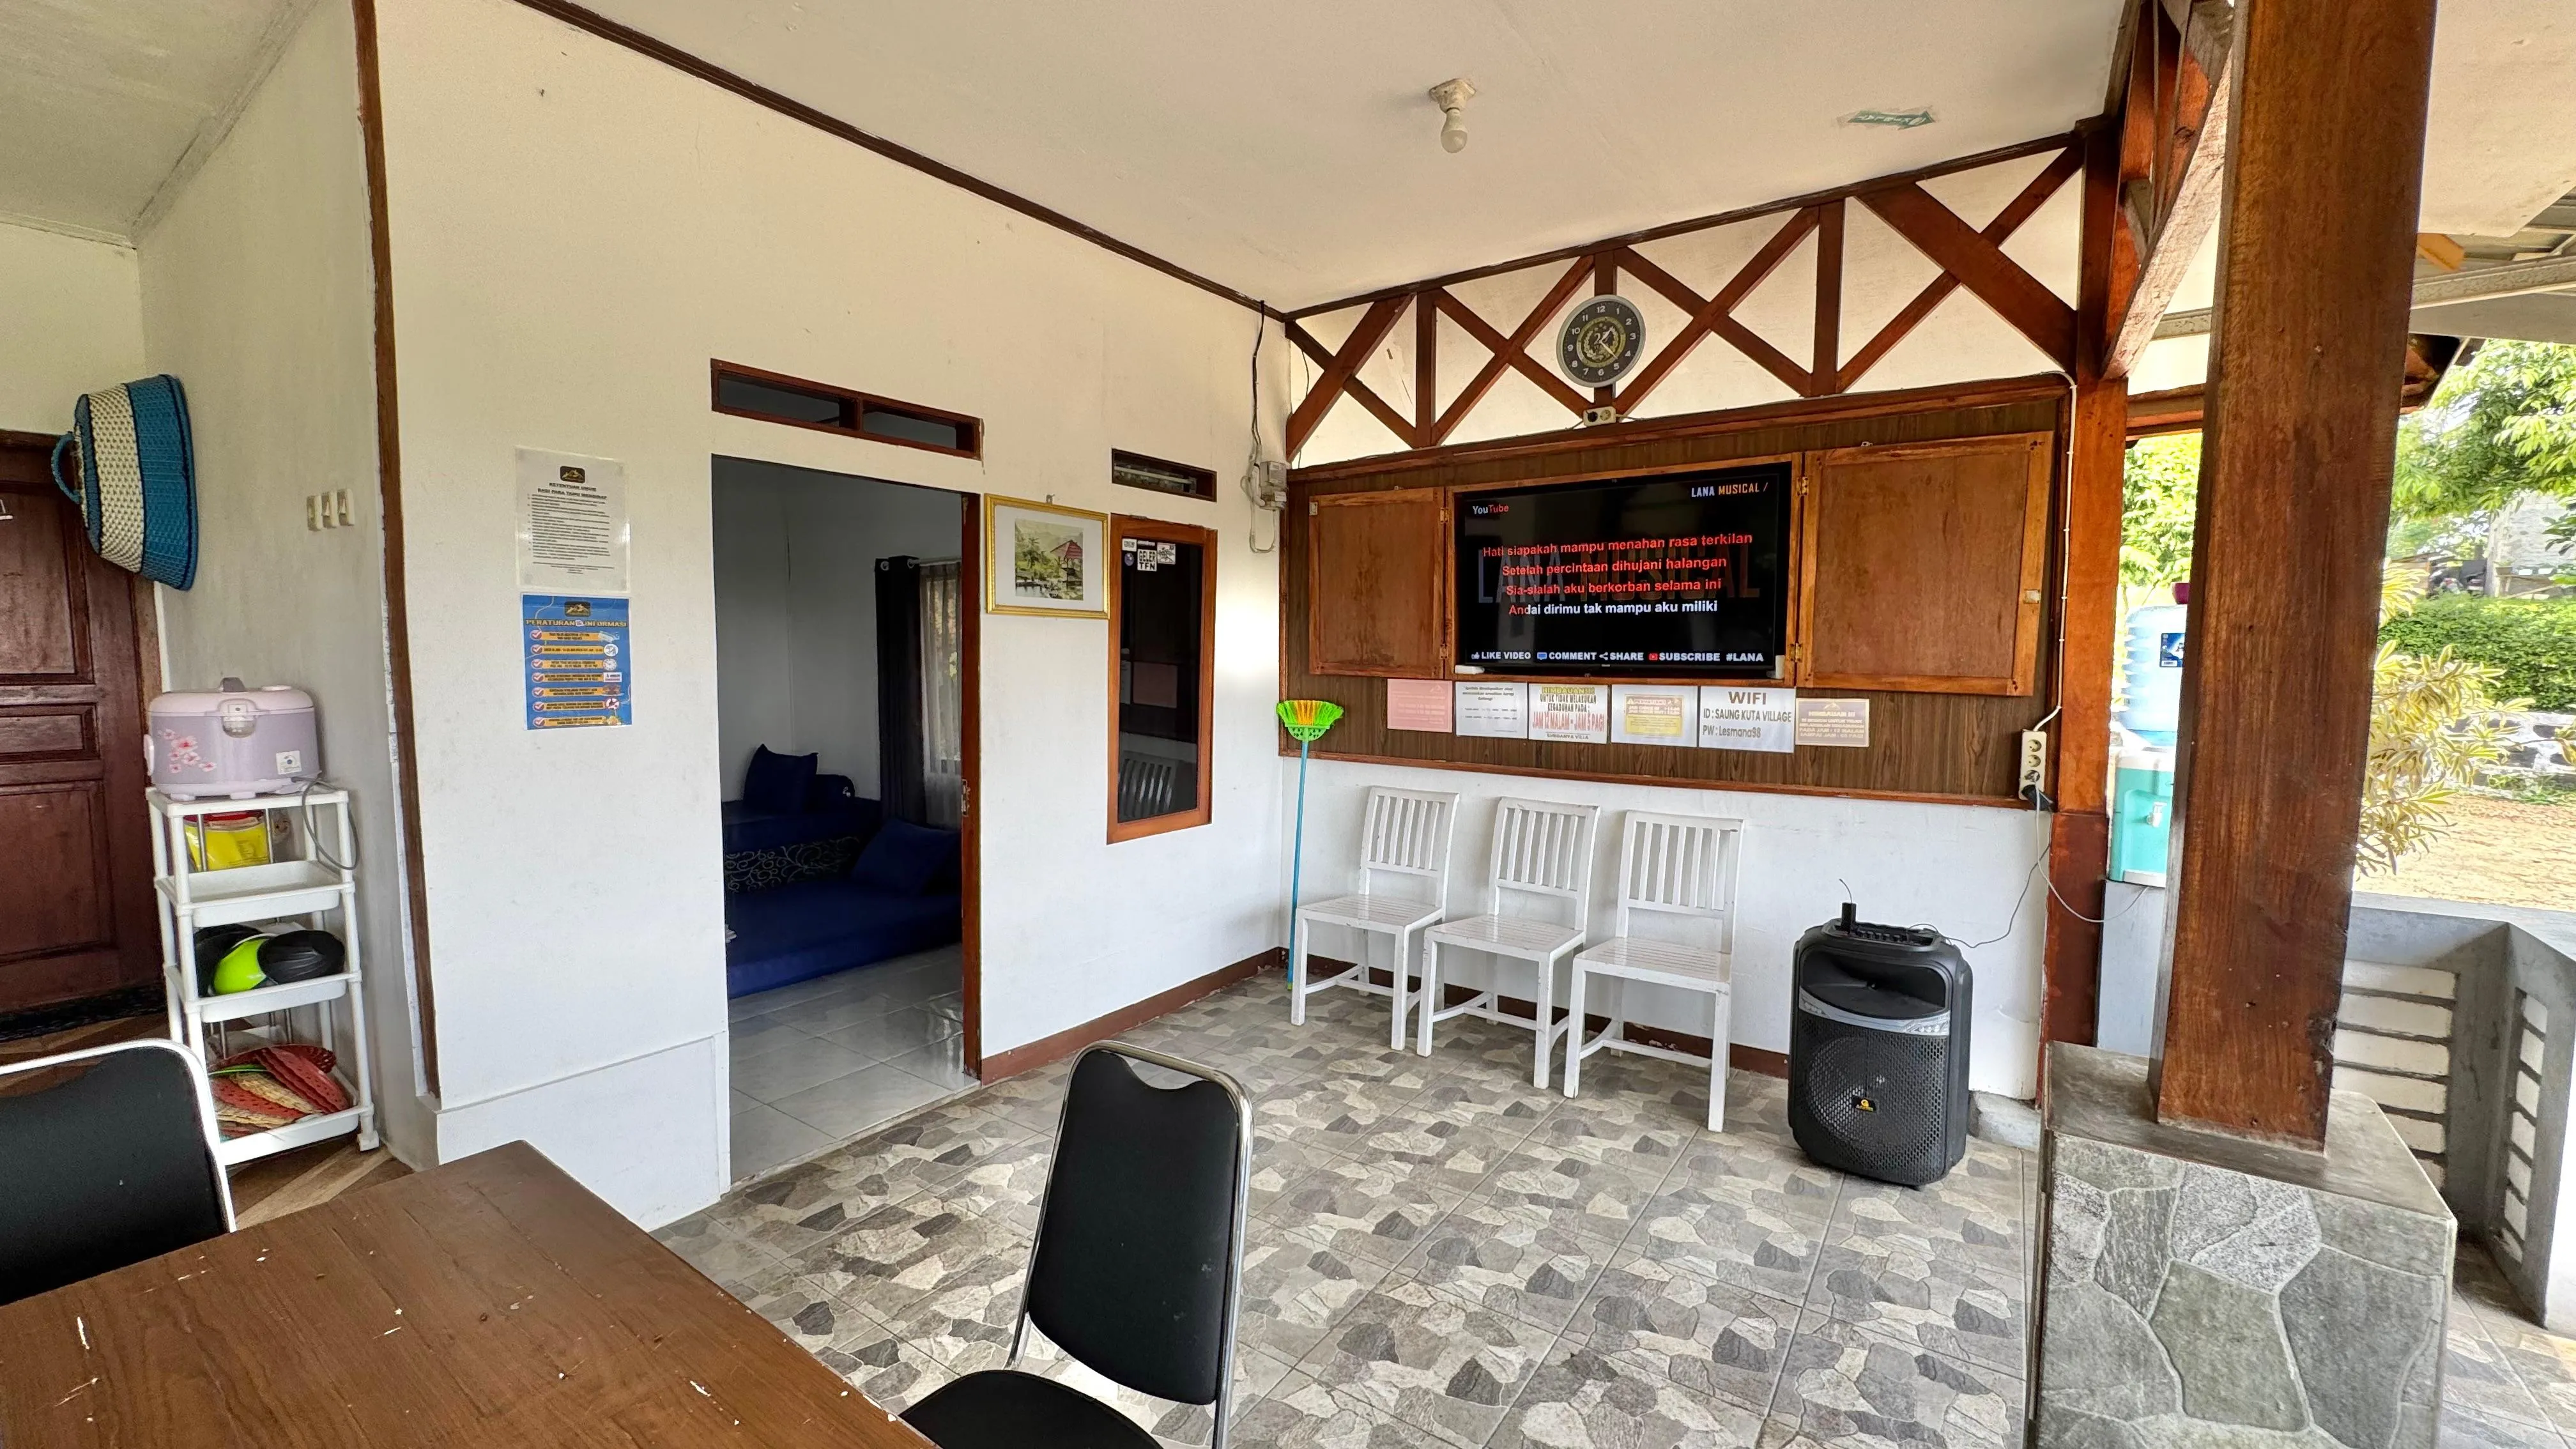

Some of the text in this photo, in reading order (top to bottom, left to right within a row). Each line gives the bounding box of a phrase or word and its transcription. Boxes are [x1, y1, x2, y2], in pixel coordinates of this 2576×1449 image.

[1691, 486, 1715, 498] LANA
[1719, 483, 1759, 495] MUSICAL
[1473, 504, 1509, 514] YouTube
[1507, 544, 1557, 558] siapakah
[1561, 542, 1604, 554] mampu
[1608, 539, 1665, 550] menahan
[1669, 537, 1698, 548] rasa
[1701, 533, 1752, 546] terkilan
[1503, 557, 1727, 576] Setelah percintaan dihujani halangan
[1506, 578, 1722, 595] Sia-sialah aku berkorban selama ini
[1508, 600, 1718, 615] Andai dirimu tak mampu aku miliki
[1549, 652, 1597, 661] COMMENT
[1610, 652, 1644, 661] SHARE
[1659, 652, 1720, 661] SUBSCRIBE
[1726, 653, 1764, 662] #LANA
[1556, 694, 1568, 703] TIDAK
[1728, 691, 1767, 705] WIFI
[1703, 709, 1710, 719] ID
[1715, 709, 1740, 720] SAUNG
[1741, 710, 1761, 721] KUTA
[1762, 711, 1791, 723] VILLAGE
[1703, 725, 1715, 735] PW
[1719, 726, 1761, 738] Lesmana98
